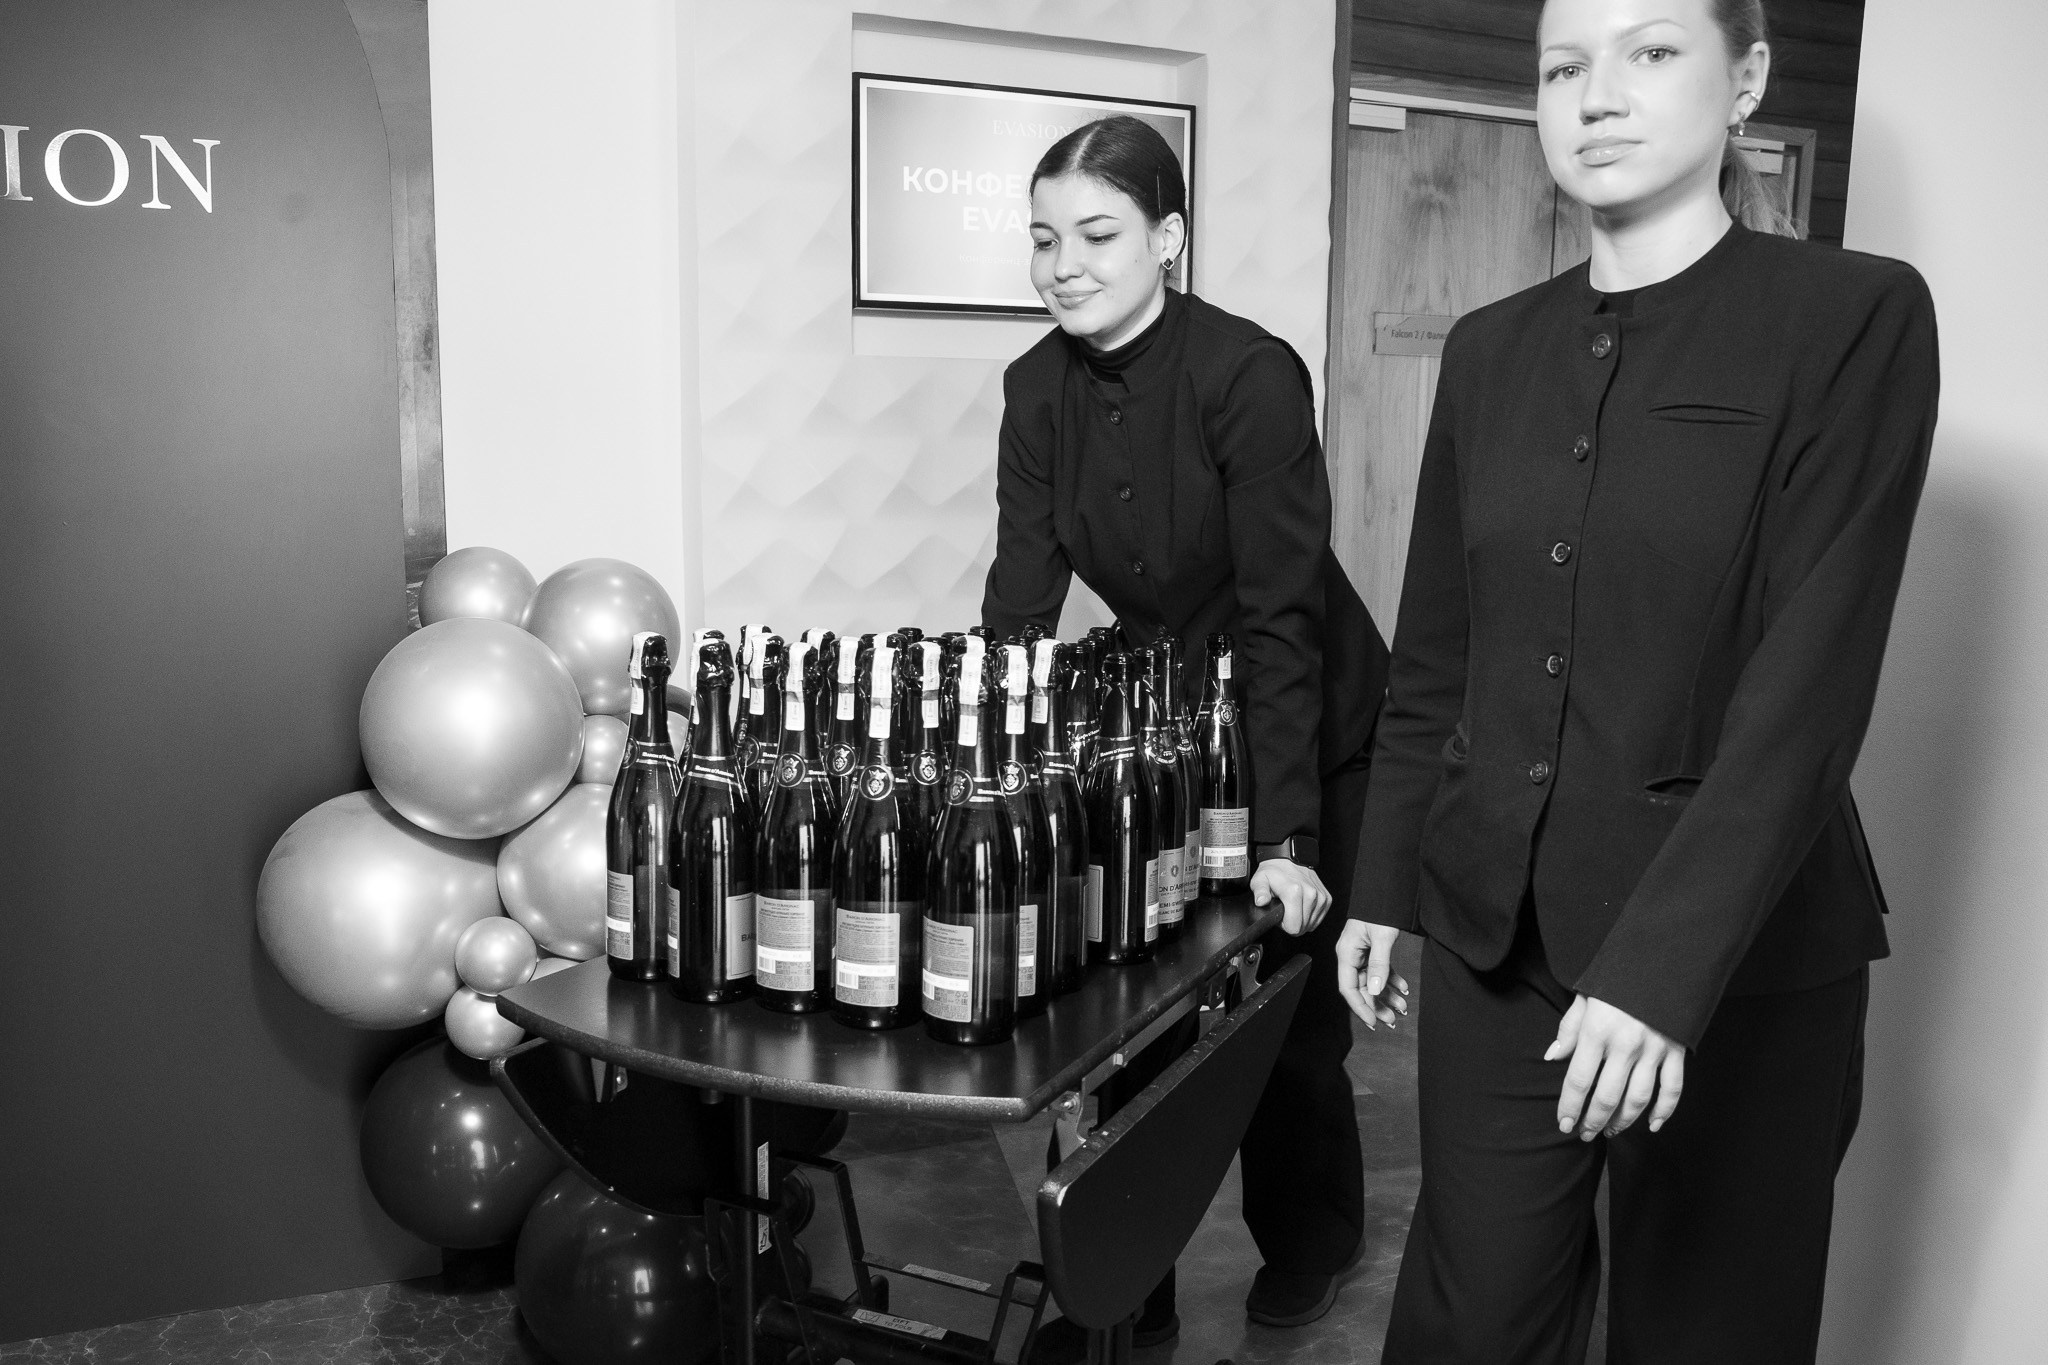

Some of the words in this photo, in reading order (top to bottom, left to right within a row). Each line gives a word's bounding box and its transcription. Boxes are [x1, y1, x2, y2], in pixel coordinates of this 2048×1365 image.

[903, 165, 1030, 199] КОНФЕ
[962, 205, 1031, 234] EVA
[1414, 330, 1419, 339] 2
